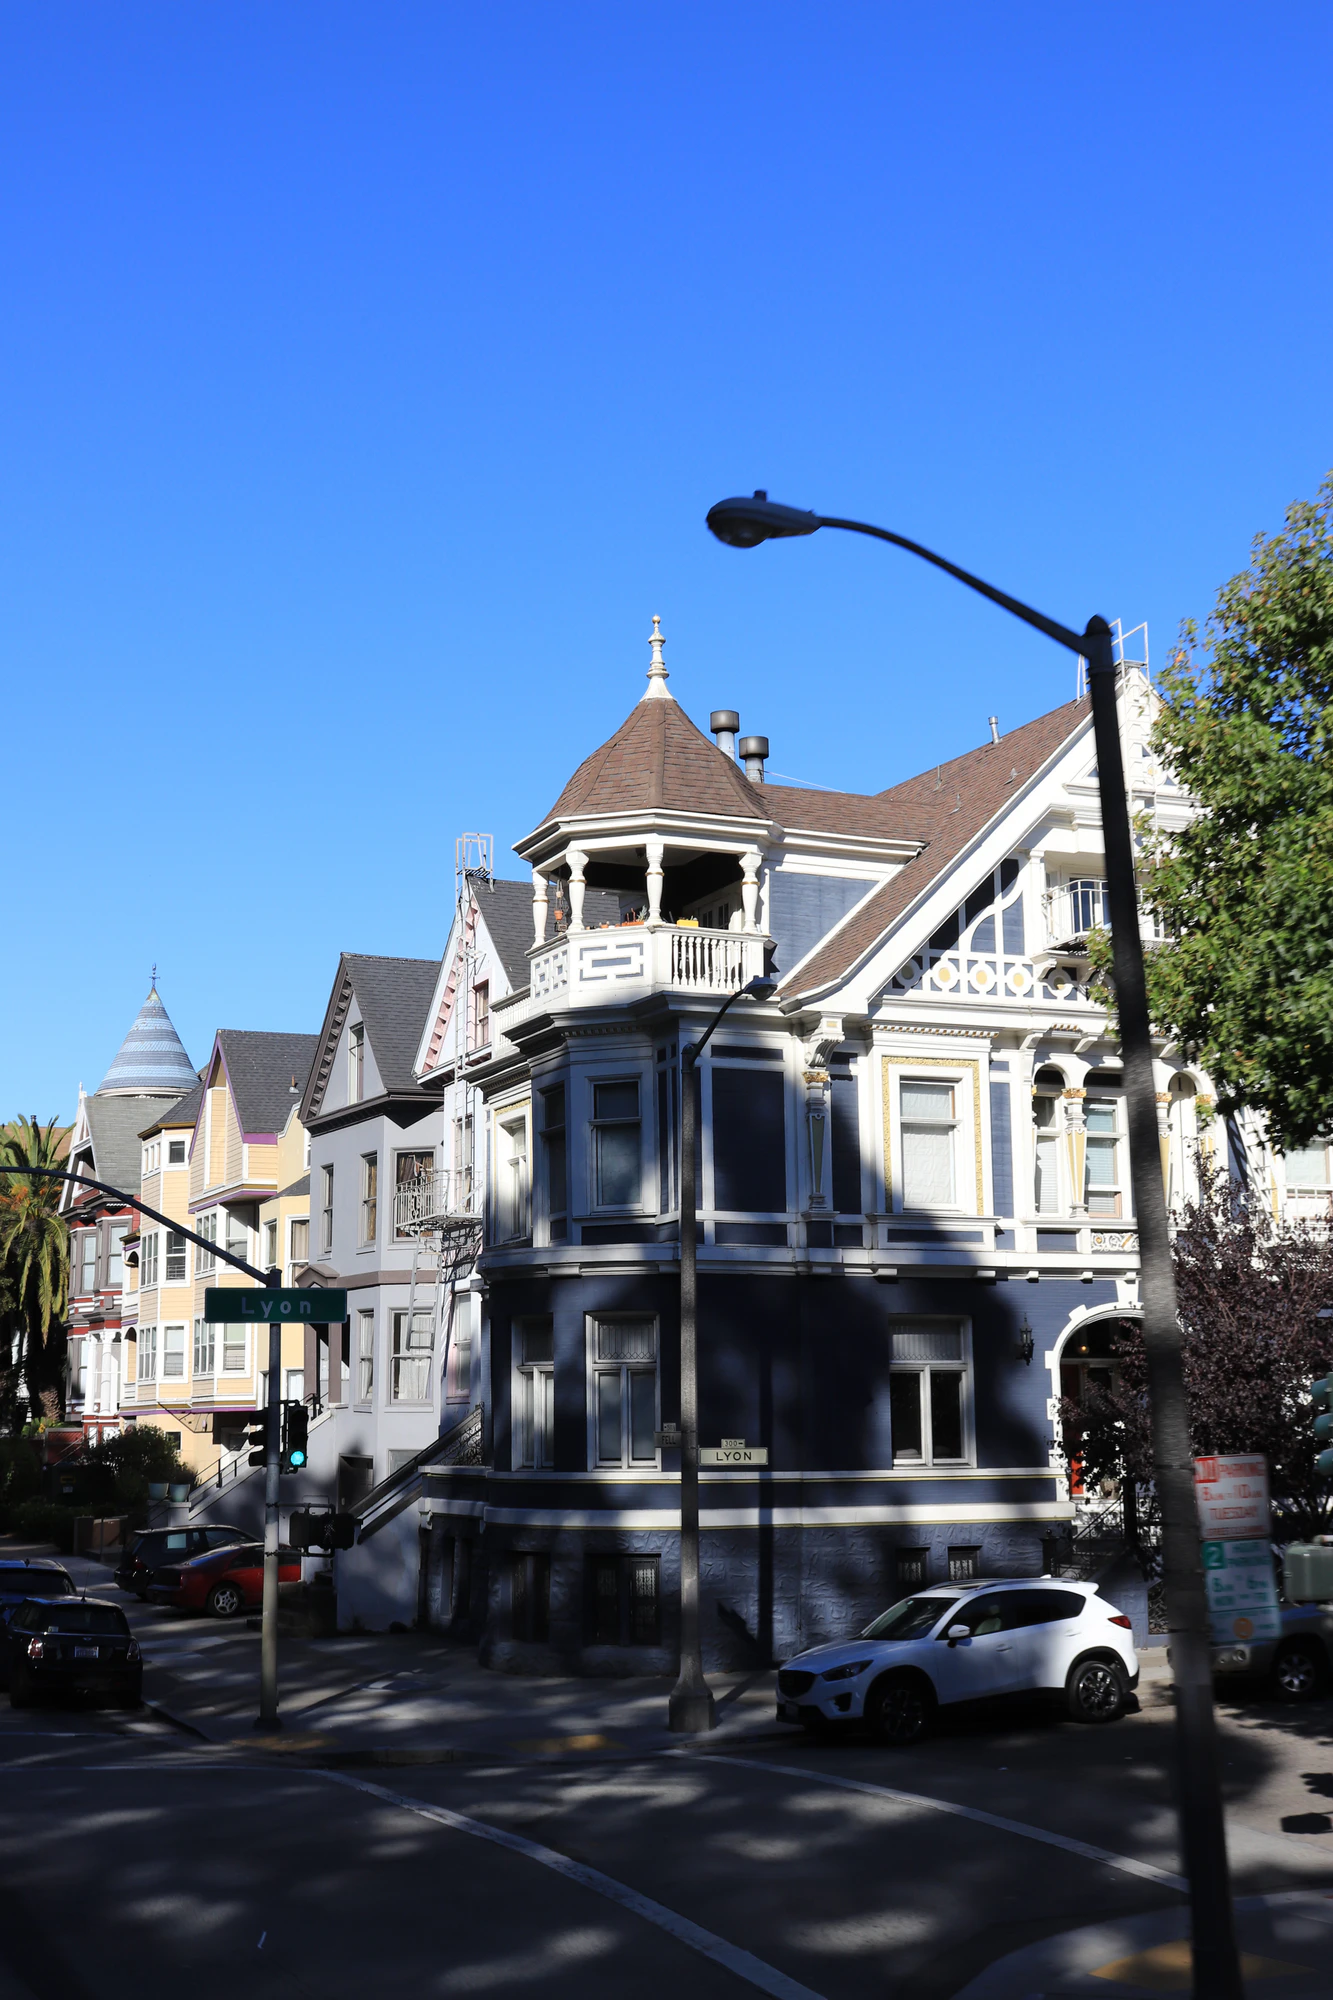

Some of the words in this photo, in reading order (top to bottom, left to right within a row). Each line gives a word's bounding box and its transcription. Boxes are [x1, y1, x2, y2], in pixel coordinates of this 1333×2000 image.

[241, 1296, 311, 1319] Lyon
[661, 1435, 677, 1445] FELL
[716, 1451, 752, 1461] LYON
[1208, 1505, 1257, 1520] TUESDAY
[1205, 1546, 1222, 1567] 2
